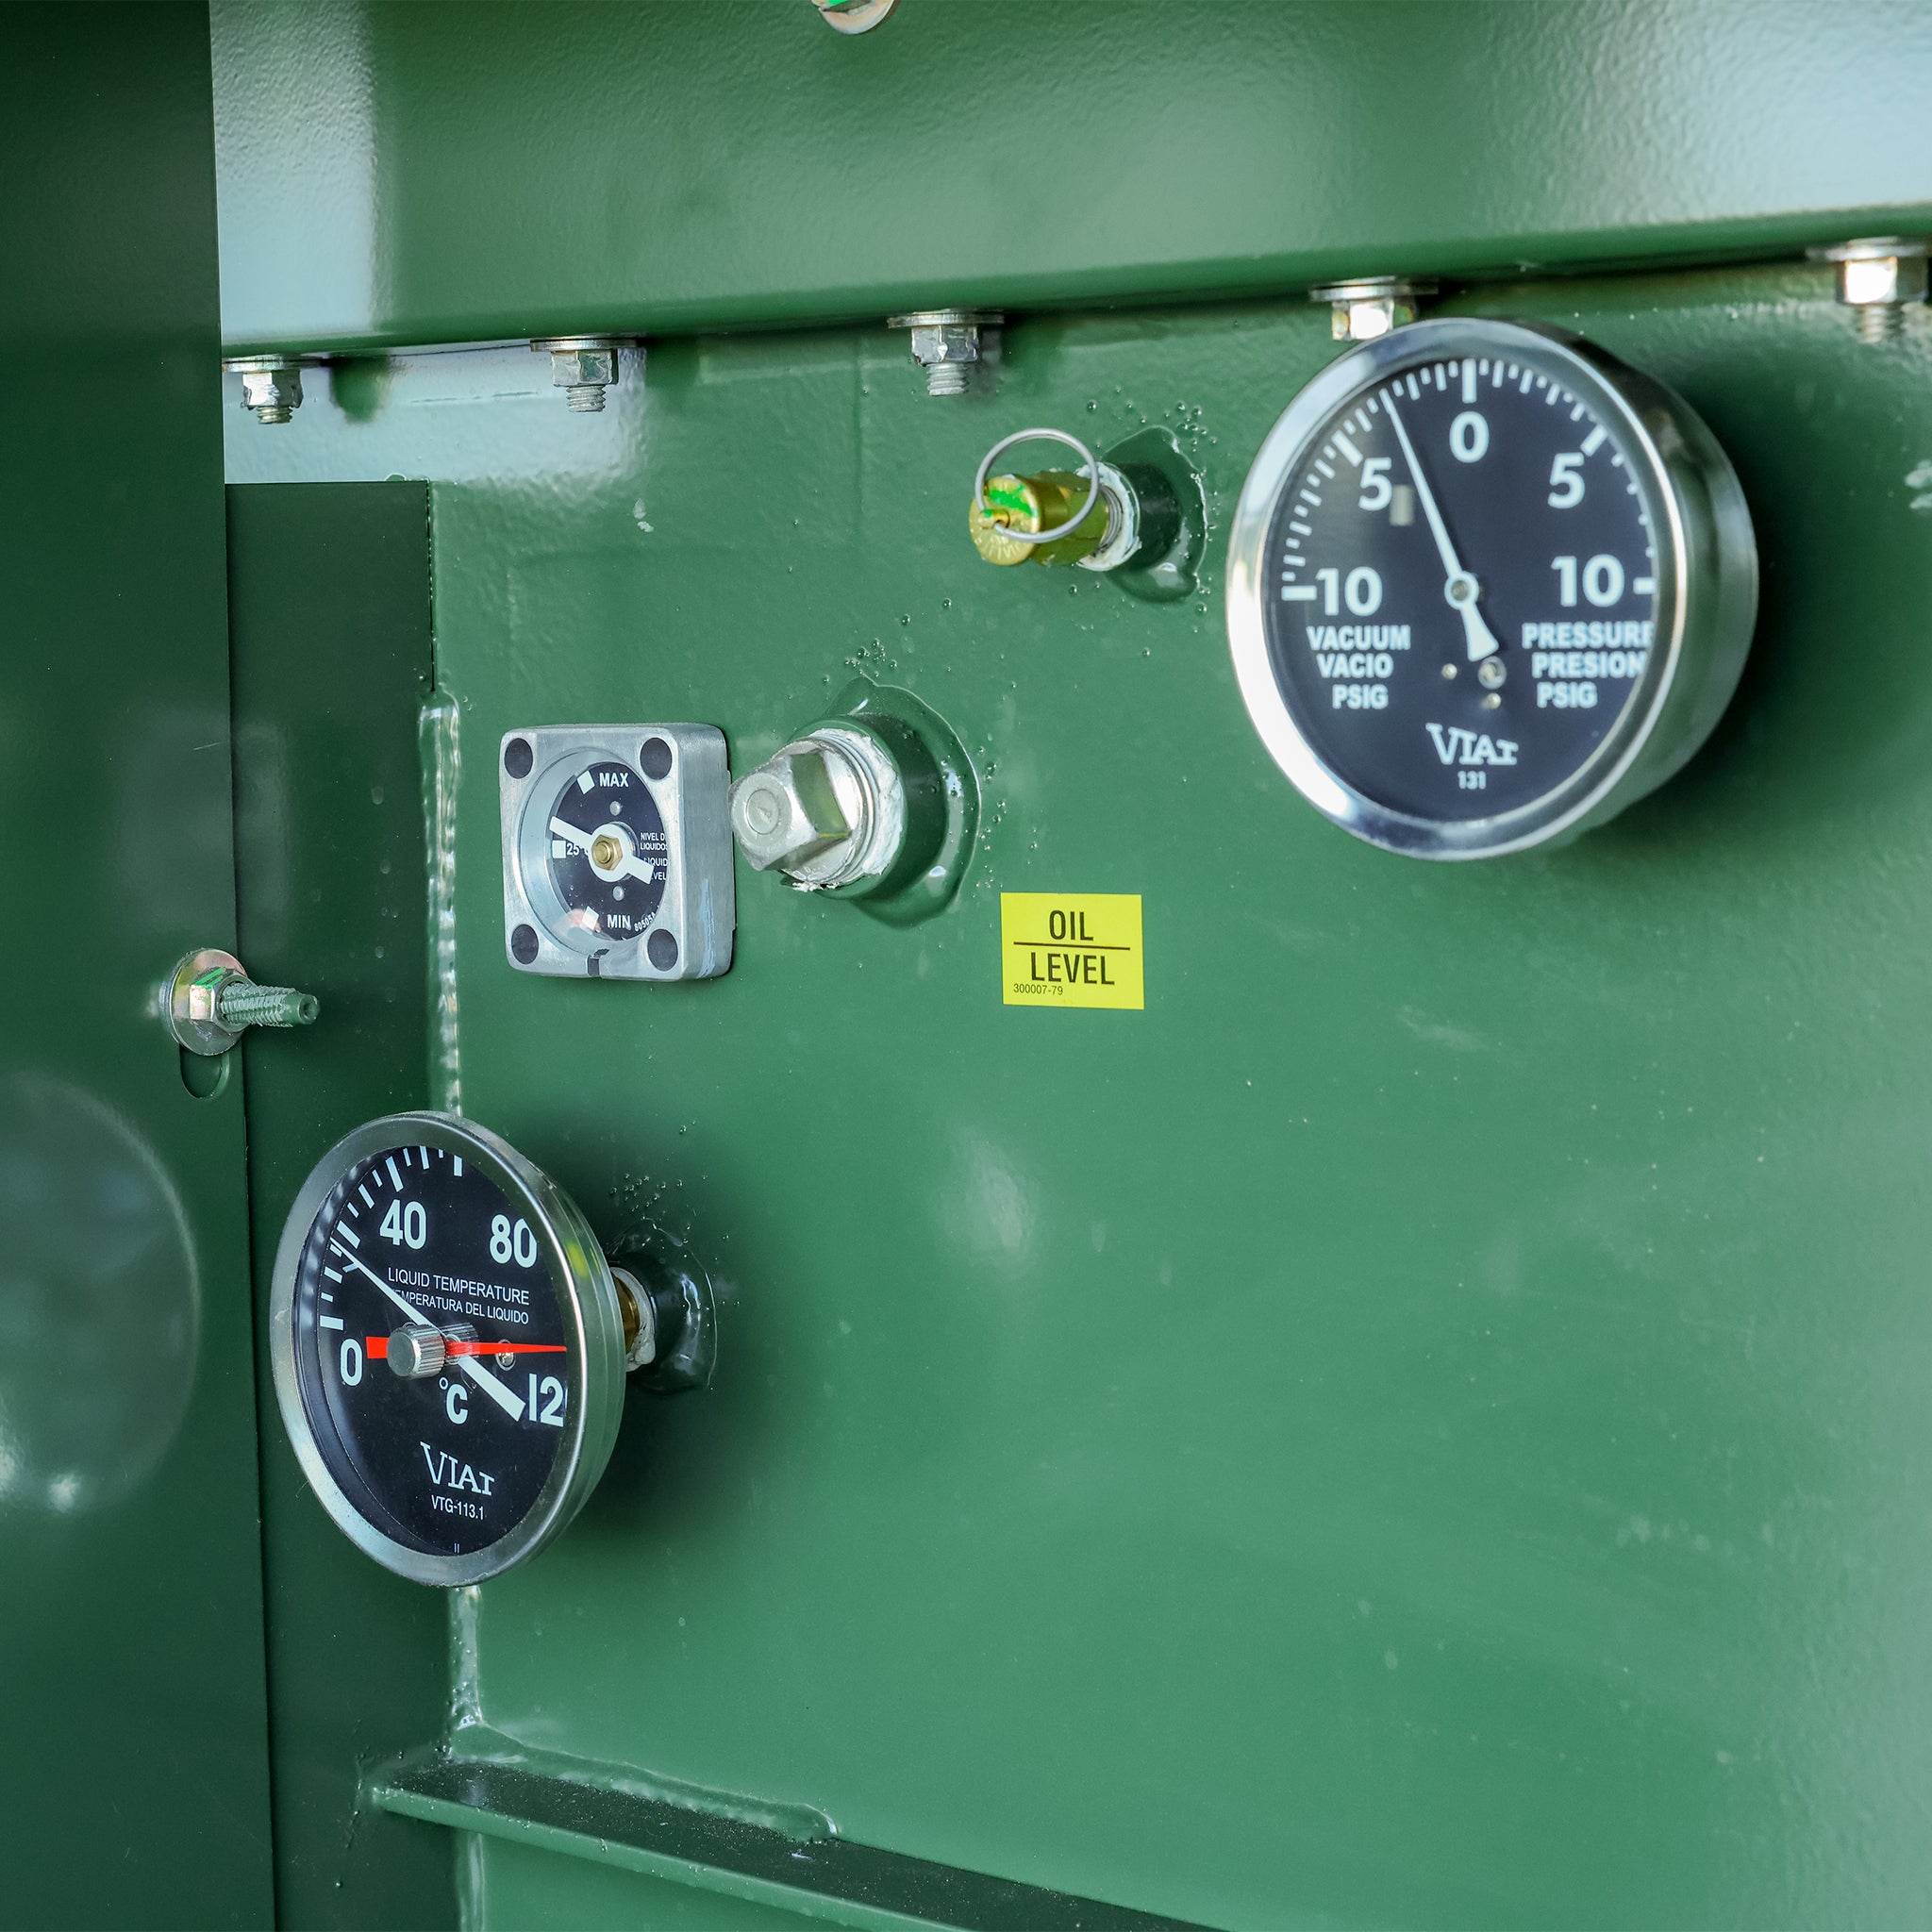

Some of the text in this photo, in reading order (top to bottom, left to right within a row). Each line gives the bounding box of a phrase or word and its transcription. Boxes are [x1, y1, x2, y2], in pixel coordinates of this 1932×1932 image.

[1448, 410, 1491, 463] 0
[1357, 458, 1394, 511] 5
[1547, 452, 1587, 509] 5
[1315, 566, 1383, 616] 10
[1551, 553, 1625, 608] 10
[1306, 625, 1411, 651] VACUUM
[1316, 653, 1394, 678] VACIO
[1332, 684, 1389, 709] PSIG
[1537, 681, 1598, 708] PSIG
[599, 772, 629, 788] MAX
[1457, 771, 1487, 790] 131
[641, 832, 658, 841] NIVEL
[607, 914, 631, 929] MIN
[1049, 909, 1094, 941] OIL
[1030, 952, 1115, 986] LEVEL
[1013, 983, 1063, 996] 300007-79
[379, 1199, 427, 1251] 40
[489, 1213, 539, 1268] 80
[388, 1267, 530, 1306] LIQUID TEMPERATURE
[465, 1303, 485, 1317] DEL
[487, 1306, 529, 1325] LIQUIDO
[339, 1337, 364, 1387] 0
[528, 1373, 568, 1427] 12
[431, 1494, 484, 1520] VTG-113.1
